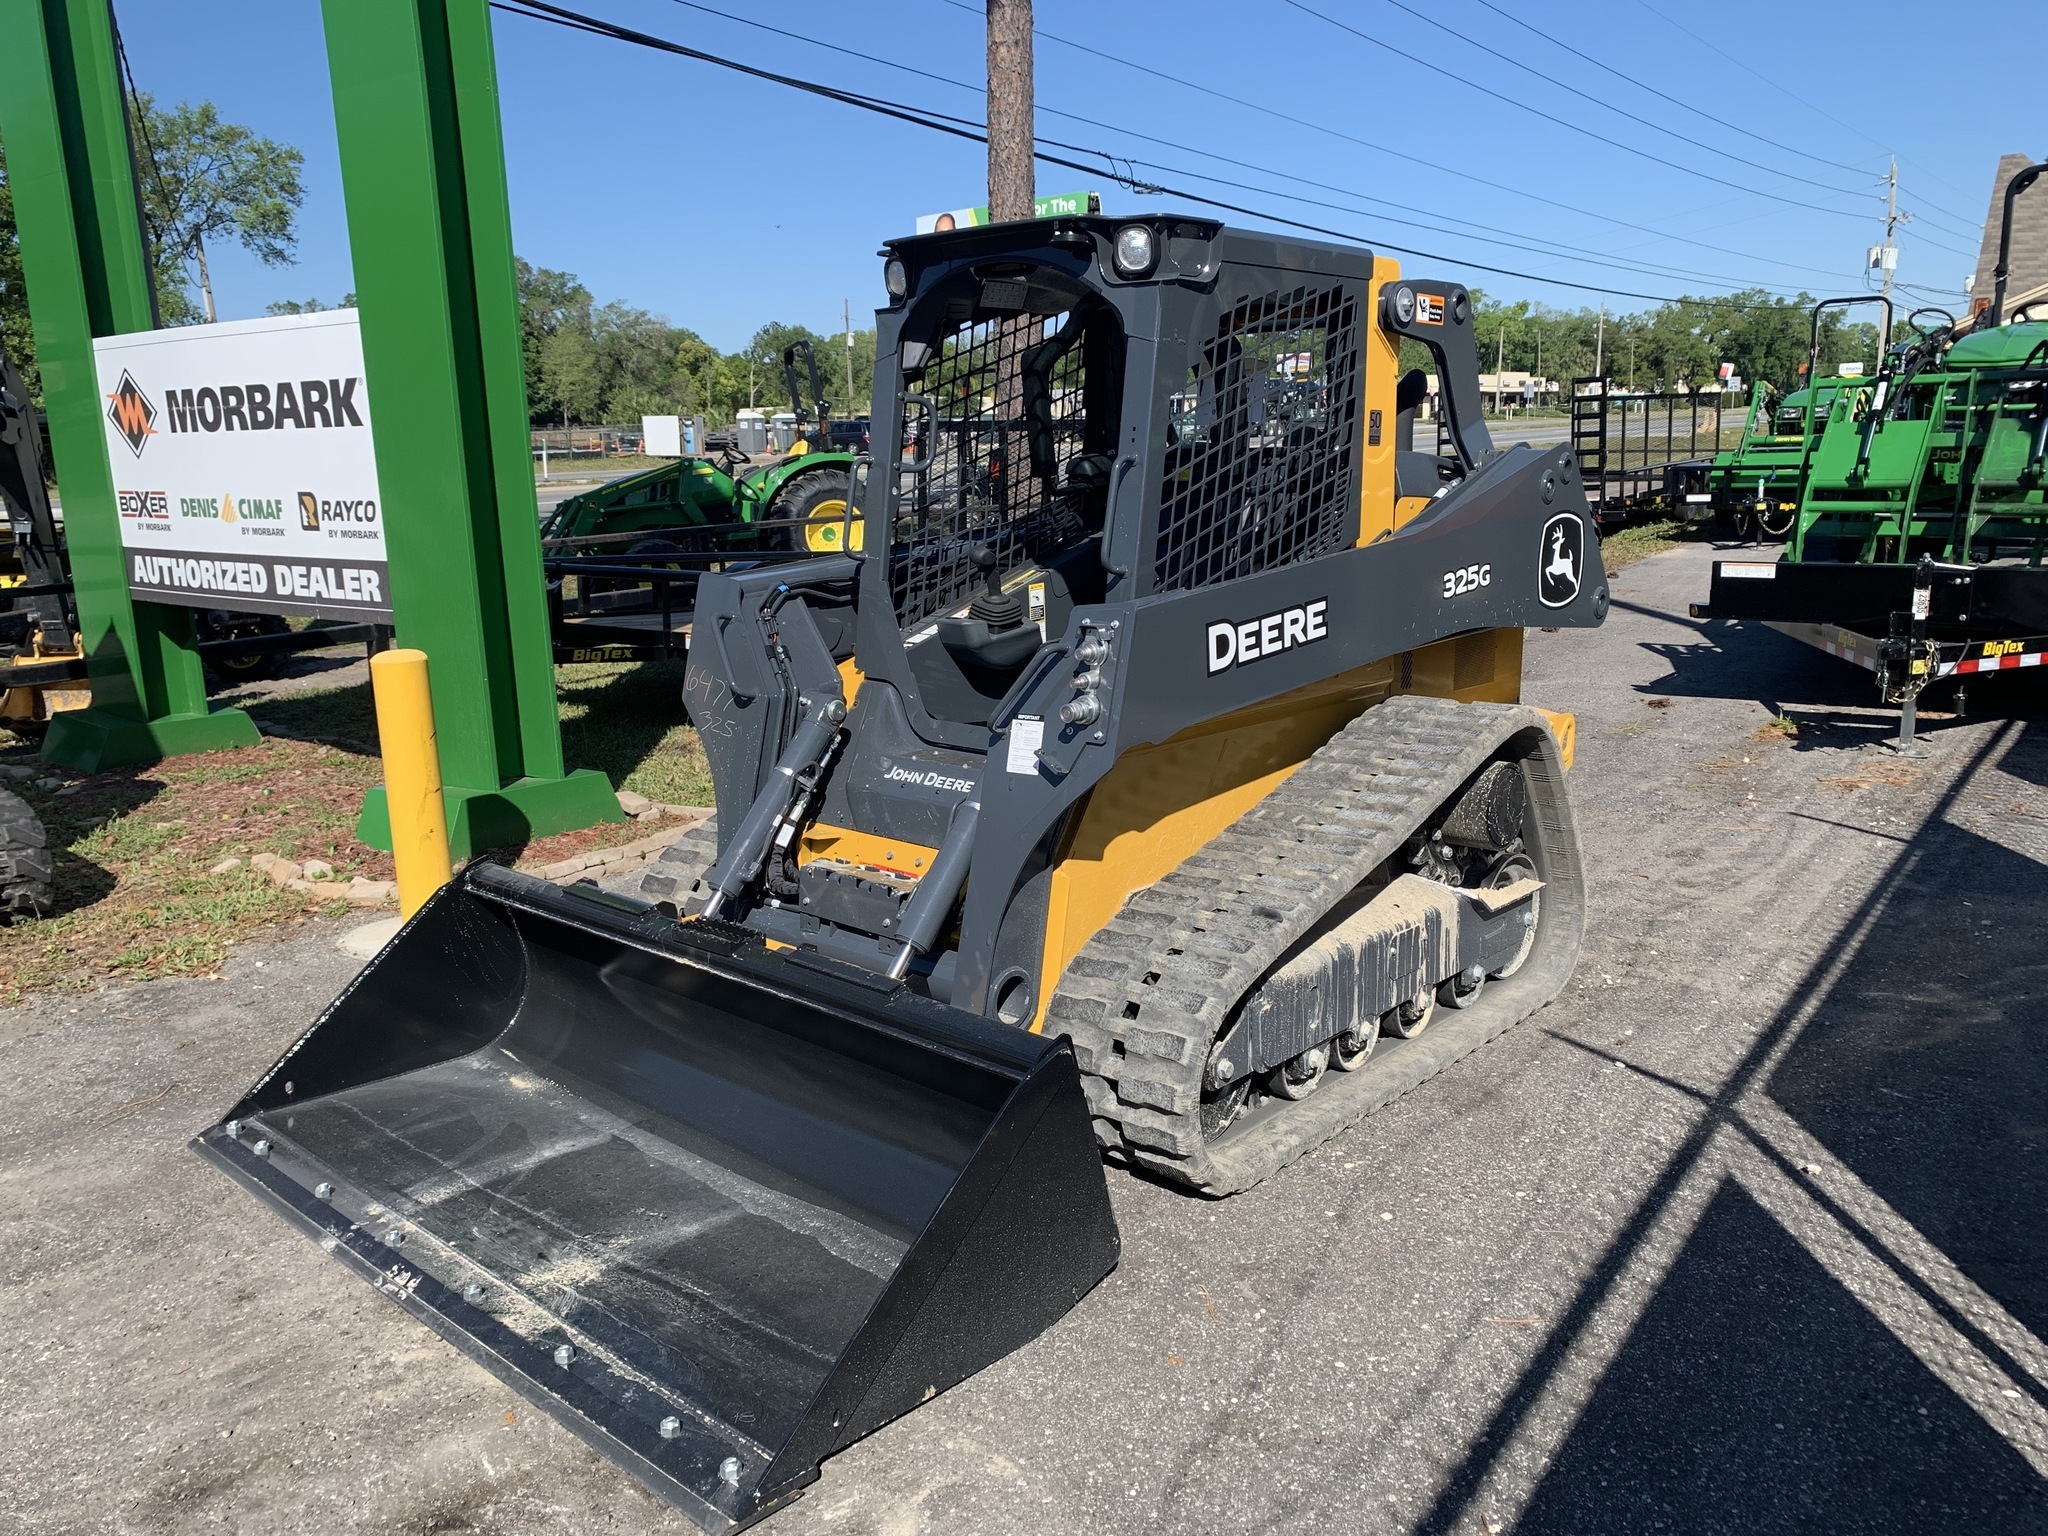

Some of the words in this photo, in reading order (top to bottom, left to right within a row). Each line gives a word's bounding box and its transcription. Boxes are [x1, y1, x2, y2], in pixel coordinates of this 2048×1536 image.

[1034, 203, 1048, 216] or
[1050, 197, 1077, 214] The
[165, 377, 364, 433] MORBARK
[1370, 412, 1381, 429] 50
[1931, 449, 1963, 460] JOH
[119, 491, 169, 518] BOXER
[180, 498, 219, 519] DENIS
[238, 499, 283, 520] CIMAF
[321, 500, 377, 523] RAYCO
[137, 522, 145, 531] BY
[146, 523, 172, 532] MORBARK
[241, 527, 250, 536] BY
[252, 528, 286, 537] MORBARK
[328, 529, 338, 539] BY
[340, 530, 380, 540] MORBARK
[134, 555, 268, 594] AUTHORIZED
[273, 564, 382, 603] DEALER
[1442, 563, 1491, 599] 325G
[1207, 600, 1327, 673] DEERE
[572, 646, 634, 663] BigTex
[1982, 640, 2025, 658] BigTex
[698, 710, 737, 737] 325
[883, 765, 925, 785] JOHN
[923, 772, 976, 793] DEERE
